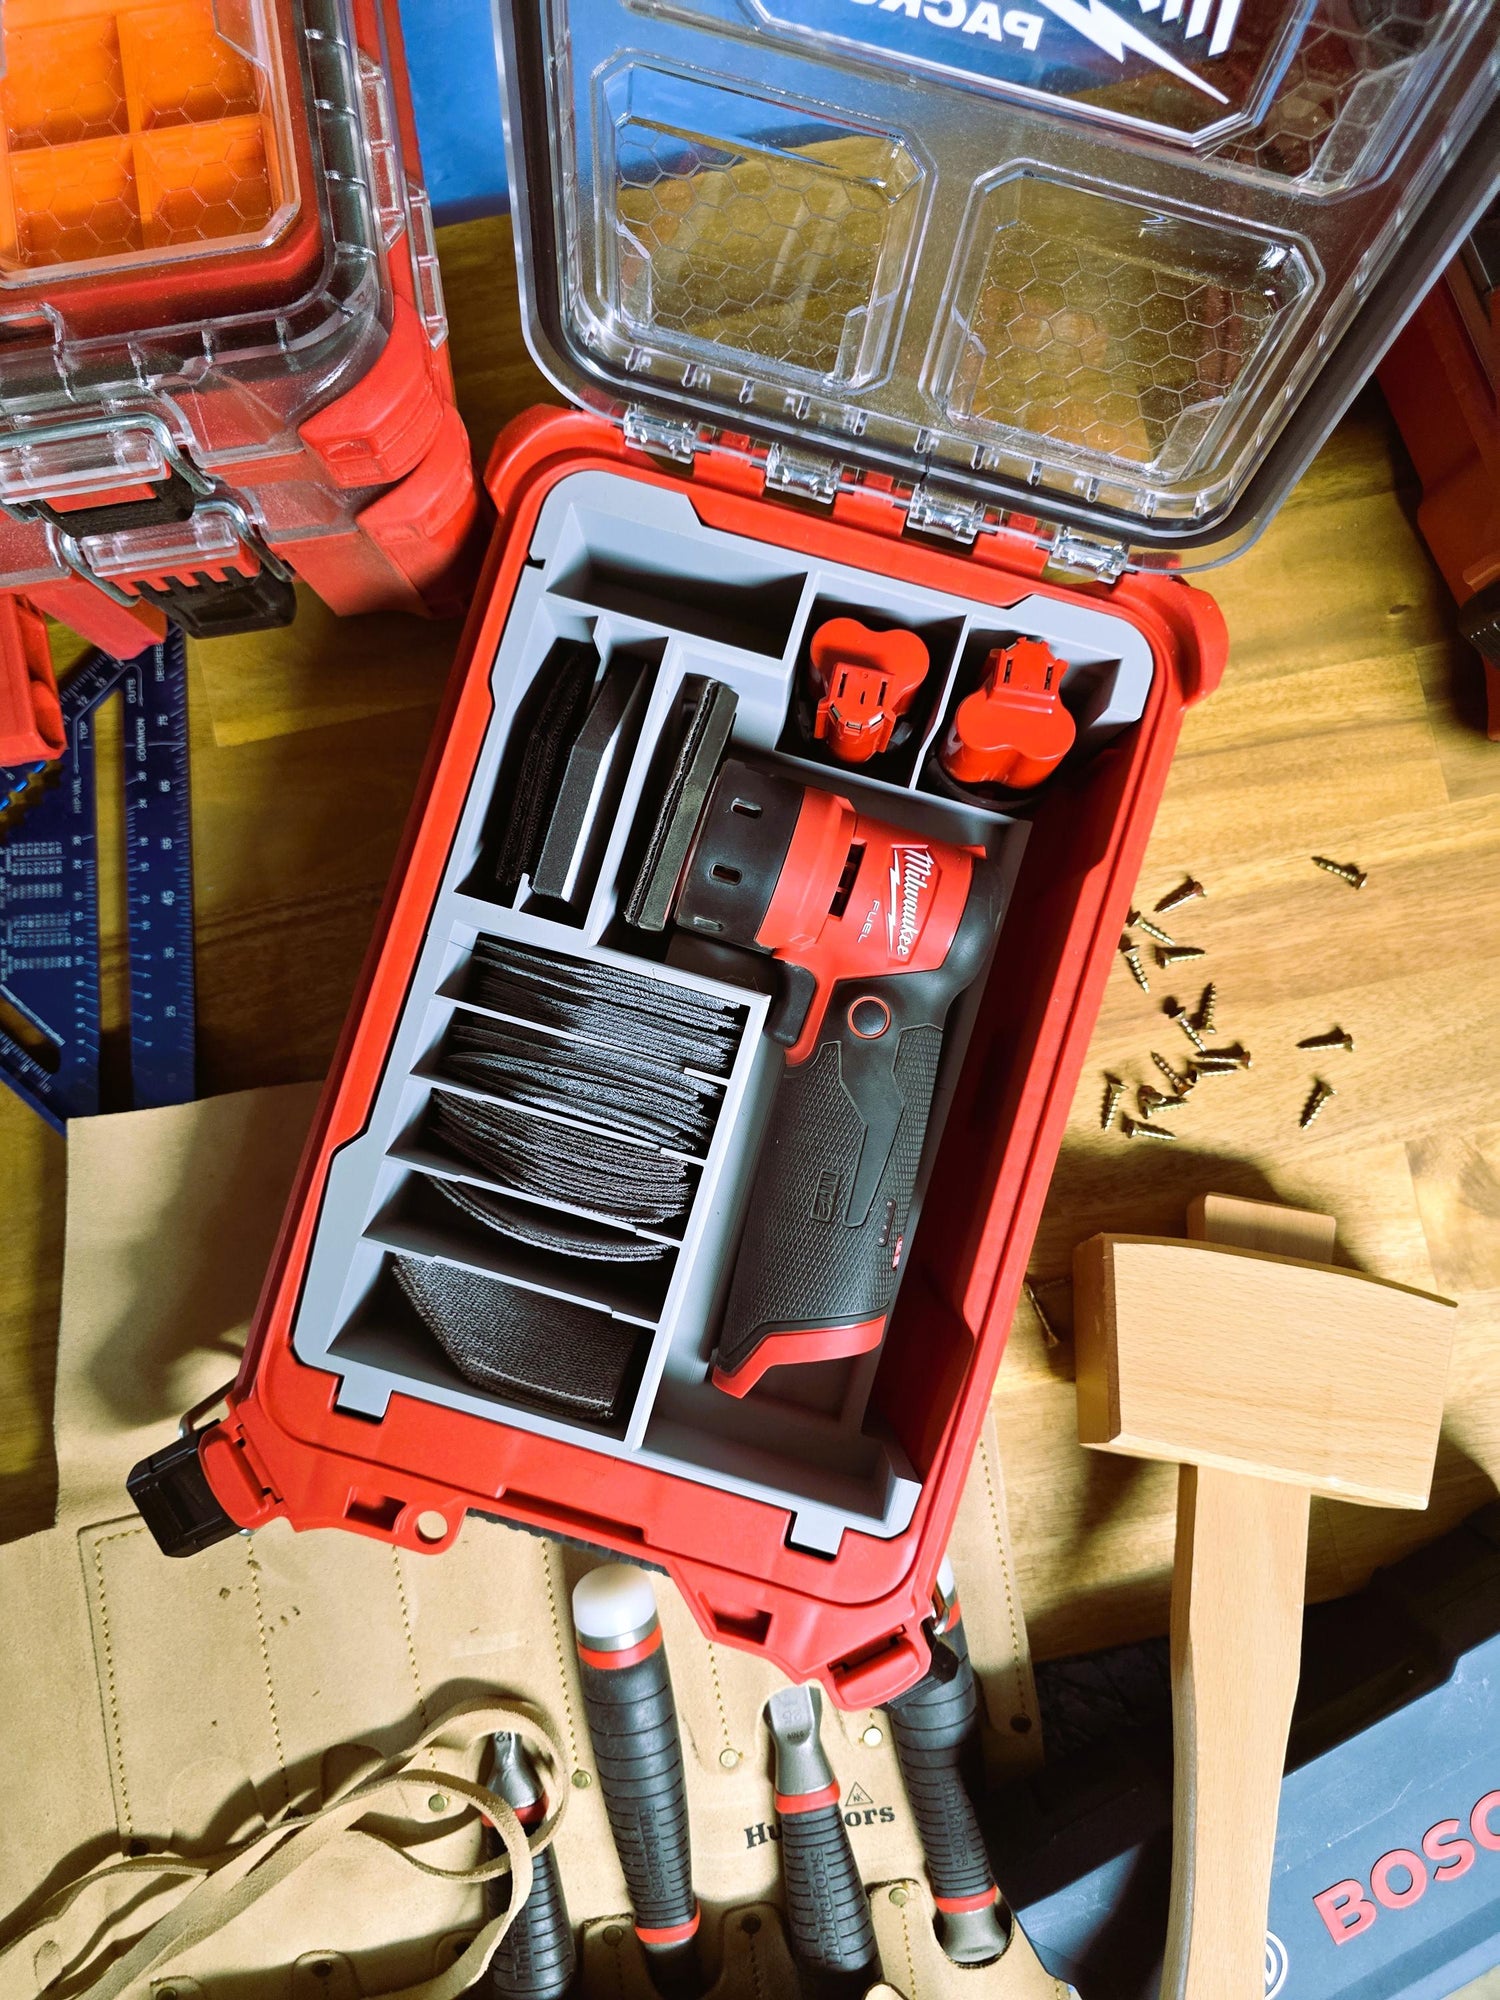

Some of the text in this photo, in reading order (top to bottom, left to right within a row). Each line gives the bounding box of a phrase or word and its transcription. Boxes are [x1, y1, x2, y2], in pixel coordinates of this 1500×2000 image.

[155, 643, 165, 682] DEGREE
[127, 678, 137, 704] CUTS
[80, 721, 88, 740] TOP
[136, 718, 147, 761] COMMON
[161, 889, 175, 906] 45
[897, 848, 934, 956] Milwaukee
[857, 899, 880, 944] FUEL
[816, 1171, 838, 1221] M12
[744, 1805, 895, 1849] Huors
